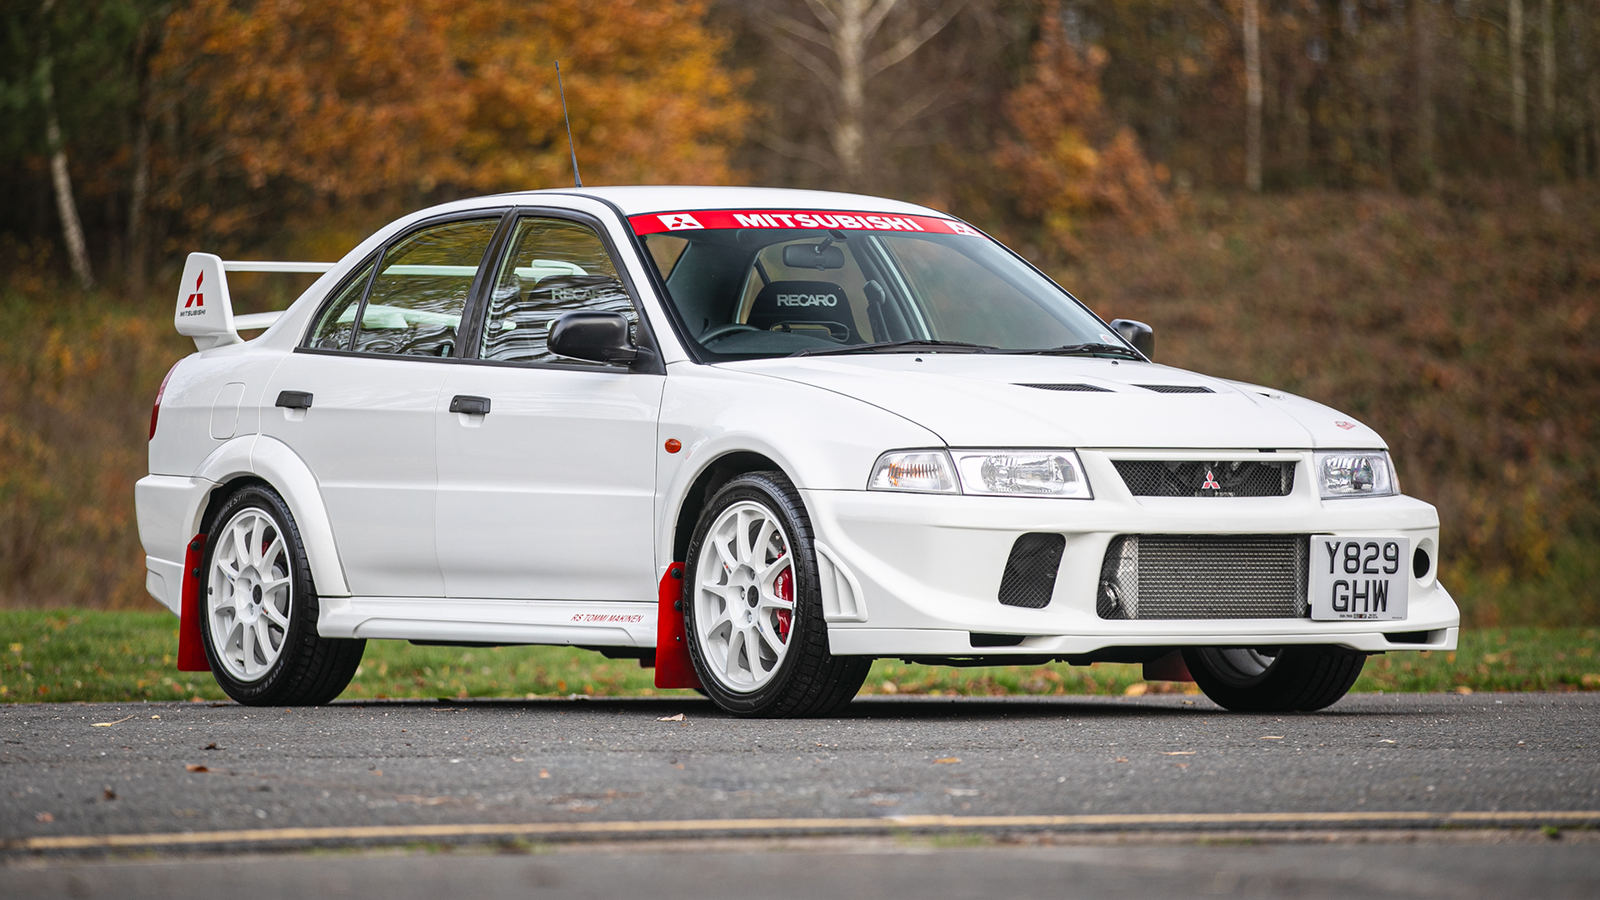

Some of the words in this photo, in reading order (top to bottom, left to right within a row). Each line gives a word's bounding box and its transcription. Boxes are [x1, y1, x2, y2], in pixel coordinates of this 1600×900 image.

[732, 213, 925, 232] MITSUBISHI
[776, 293, 838, 307] RECARO
[179, 309, 206, 317] MITSUBISHI
[1324, 541, 1400, 574] Y829
[1331, 579, 1389, 613] GHW
[570, 613, 584, 622] RS
[583, 613, 609, 622] TOMMI
[607, 614, 644, 623] MAKINEN
